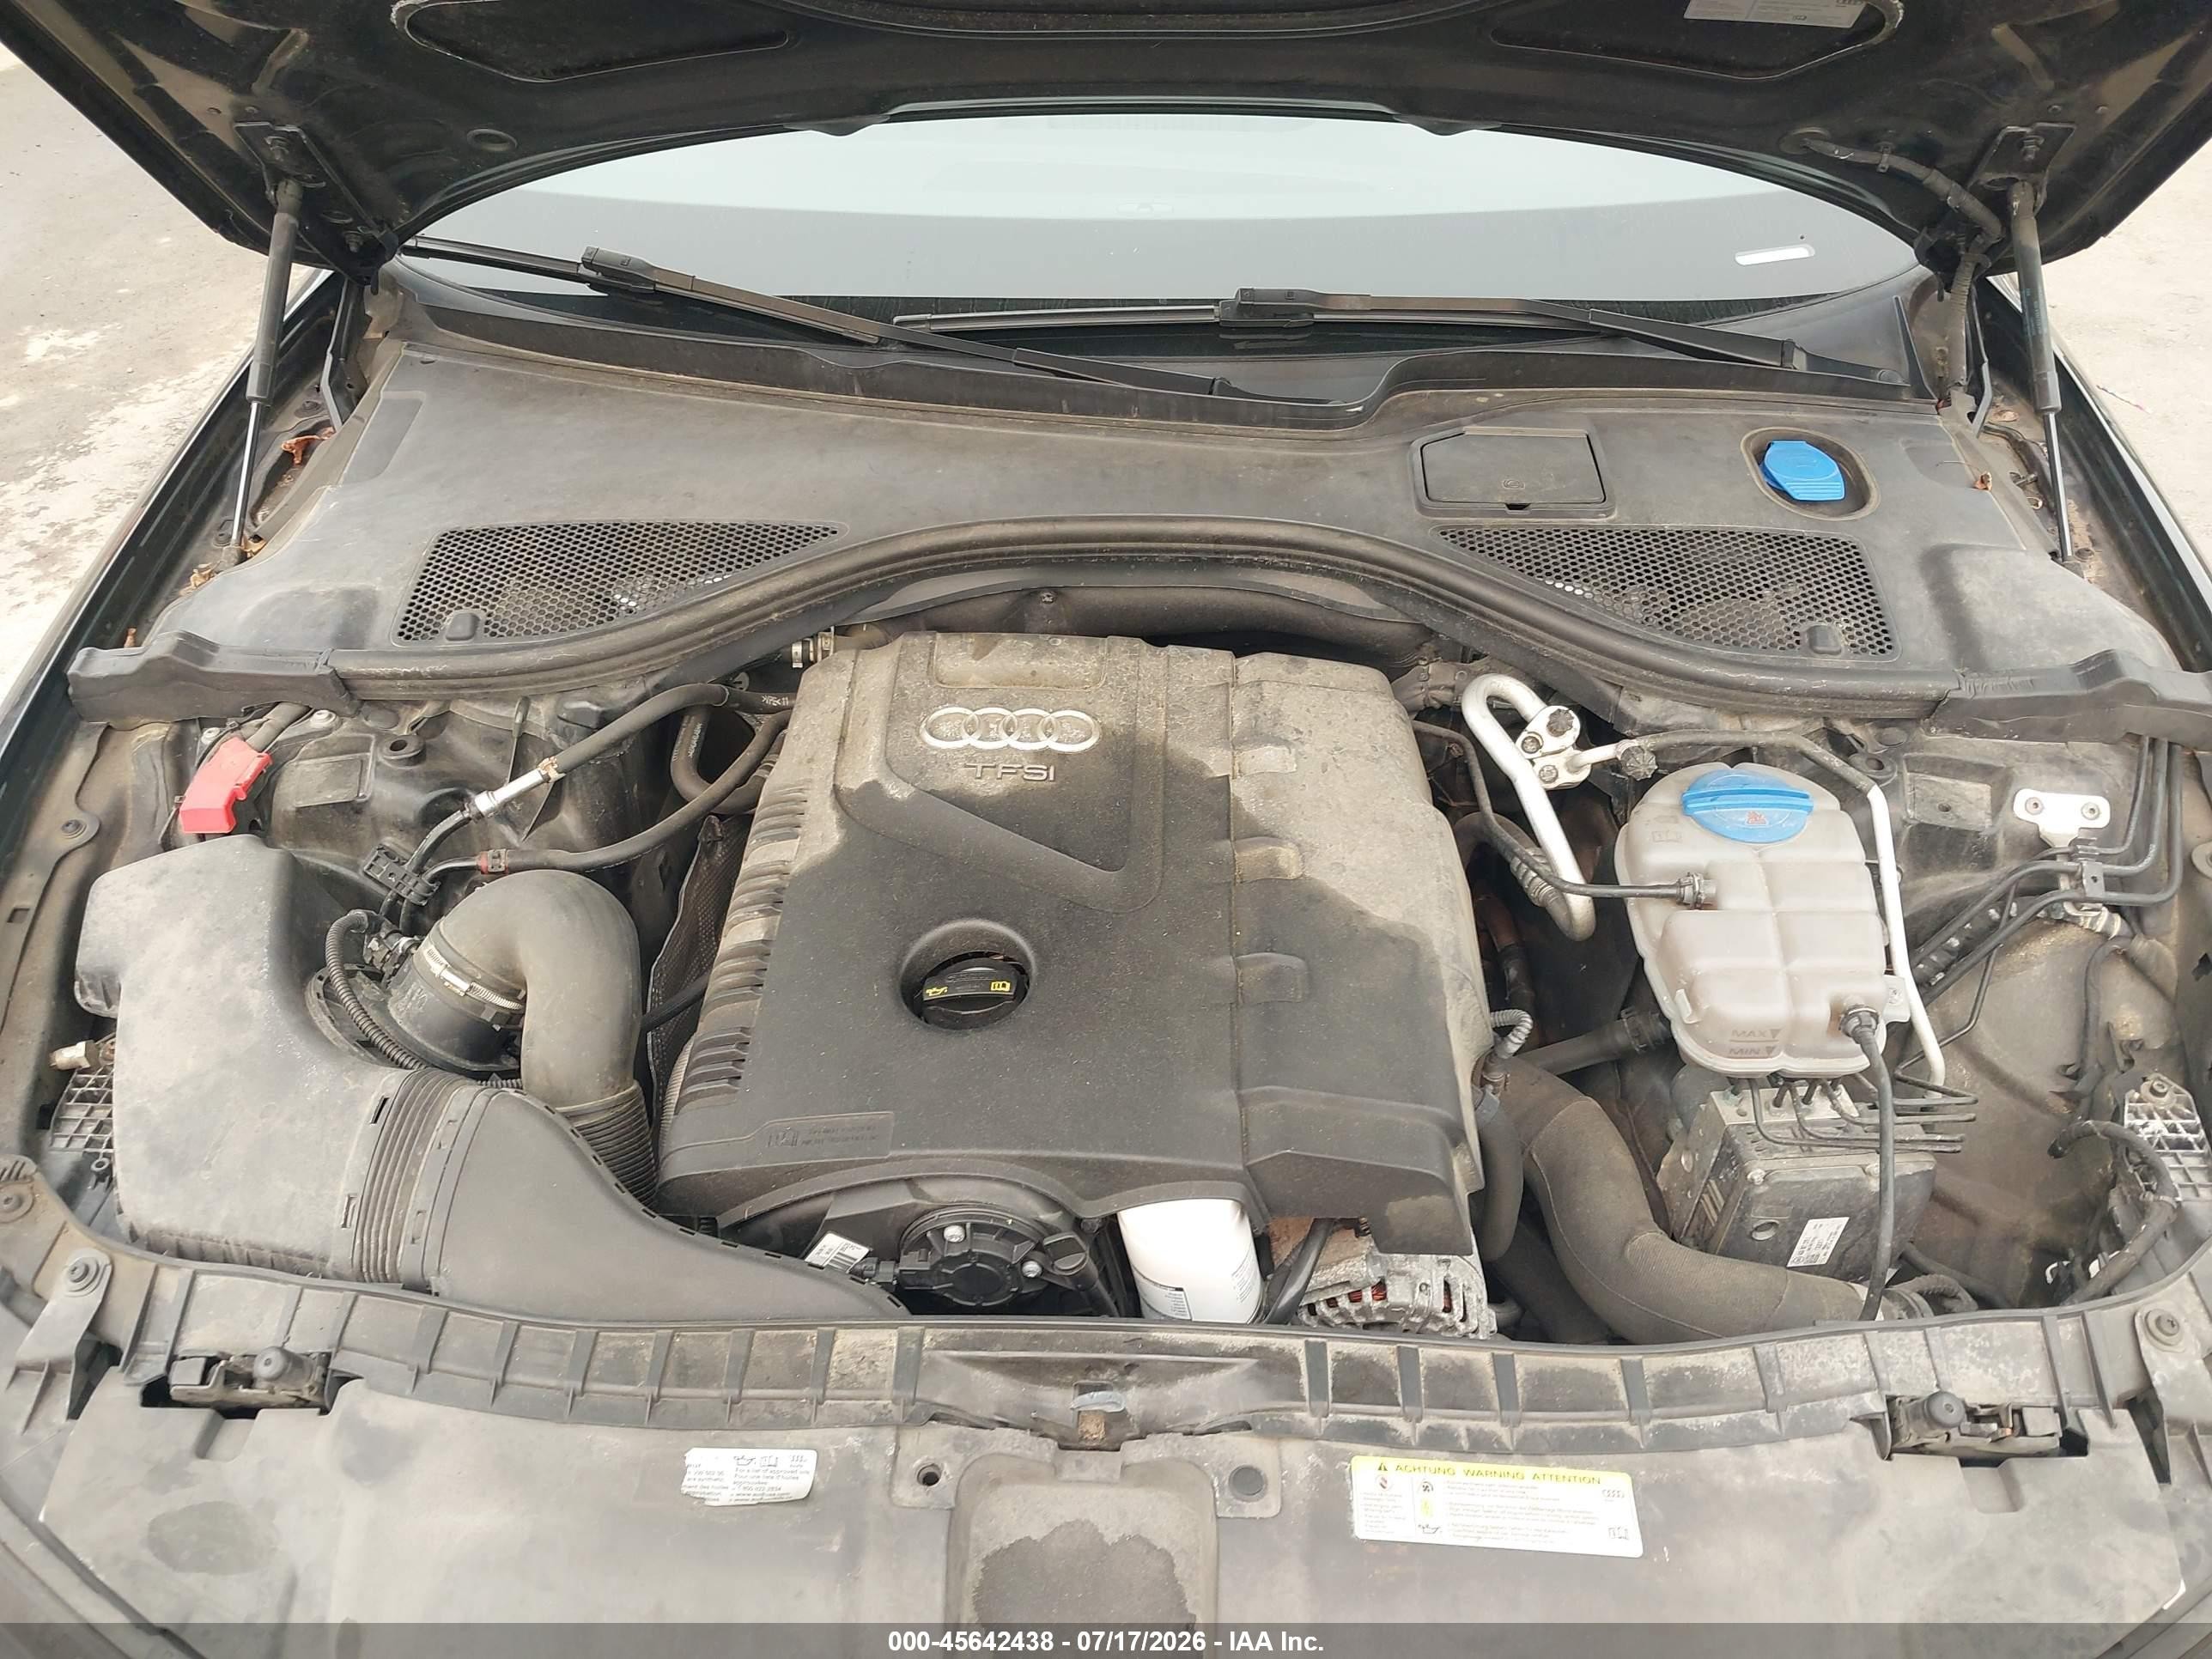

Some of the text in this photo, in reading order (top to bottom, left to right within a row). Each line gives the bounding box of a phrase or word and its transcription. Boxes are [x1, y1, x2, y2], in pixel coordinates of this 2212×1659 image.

[964, 763, 1055, 781] TFSI
[1395, 1464, 1601, 1485] ACHTUNG WARNING ATTENTION
